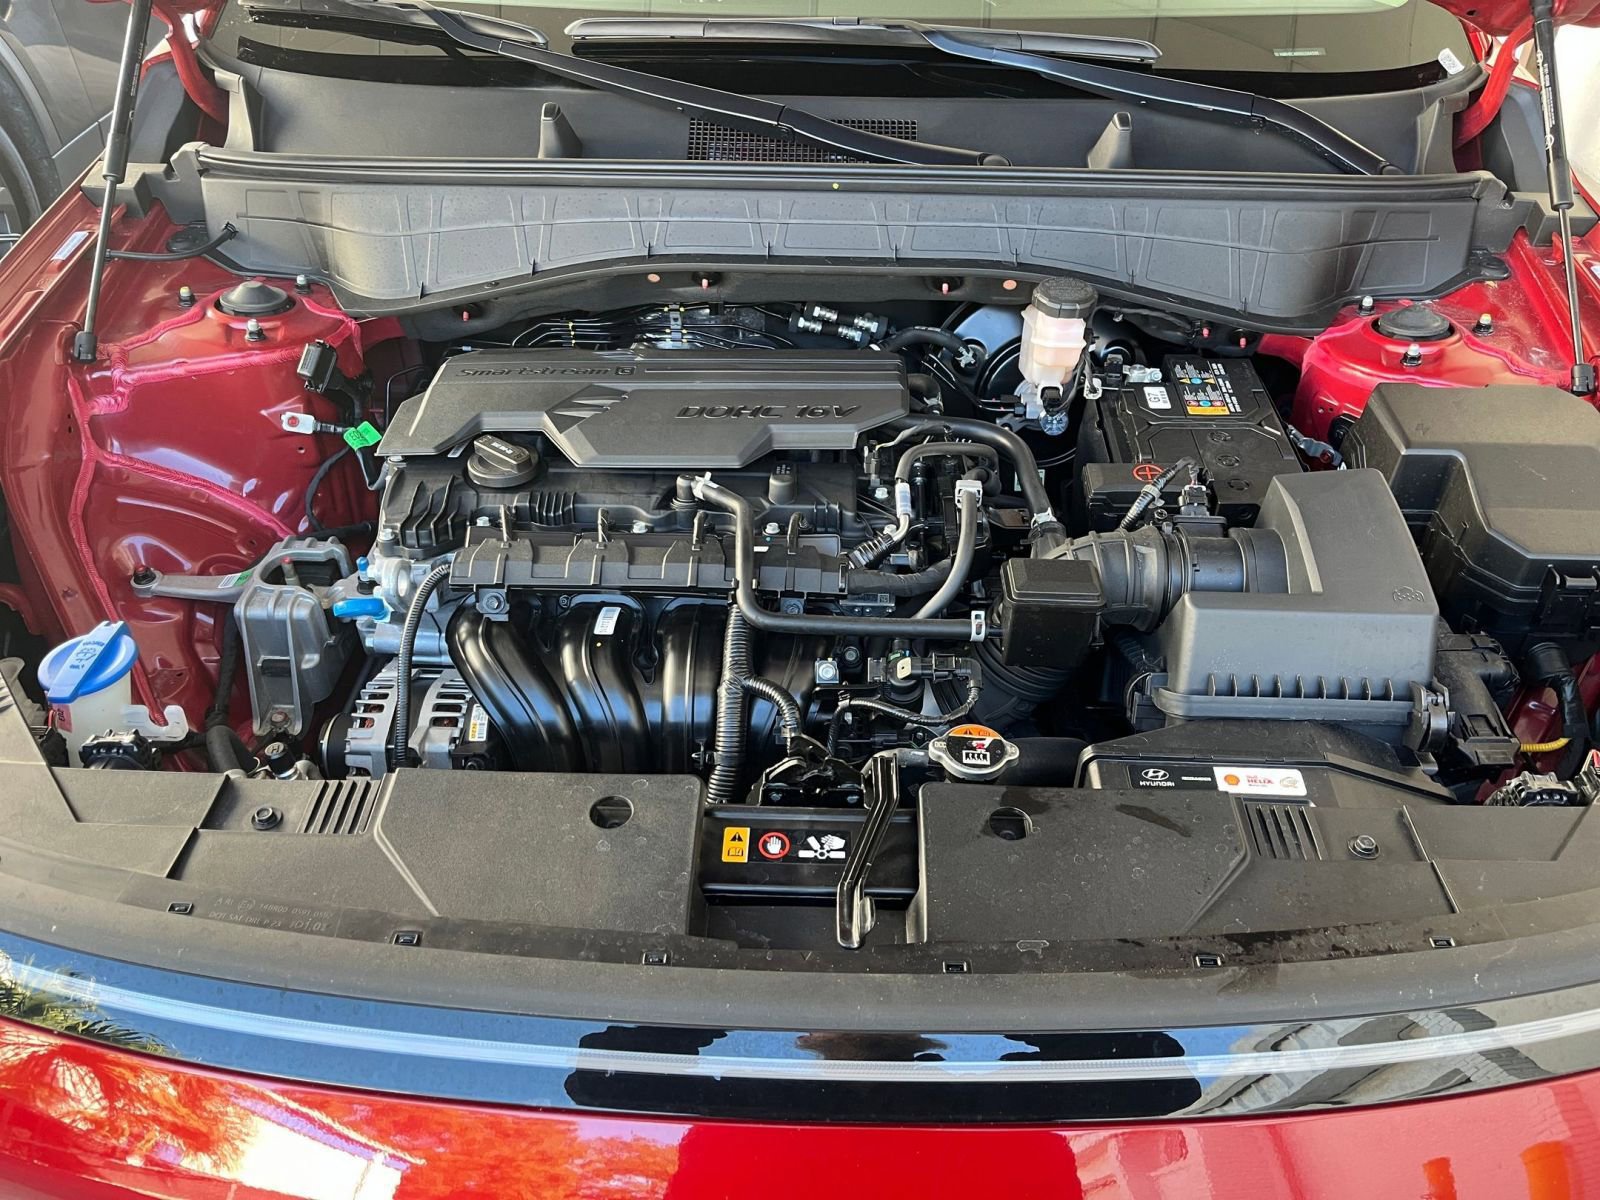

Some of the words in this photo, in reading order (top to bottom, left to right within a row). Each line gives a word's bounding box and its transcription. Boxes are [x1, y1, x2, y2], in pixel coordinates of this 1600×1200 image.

[455, 365, 611, 377] Smartstream
[674, 404, 788, 419] DOHC
[794, 404, 862, 419] 16V
